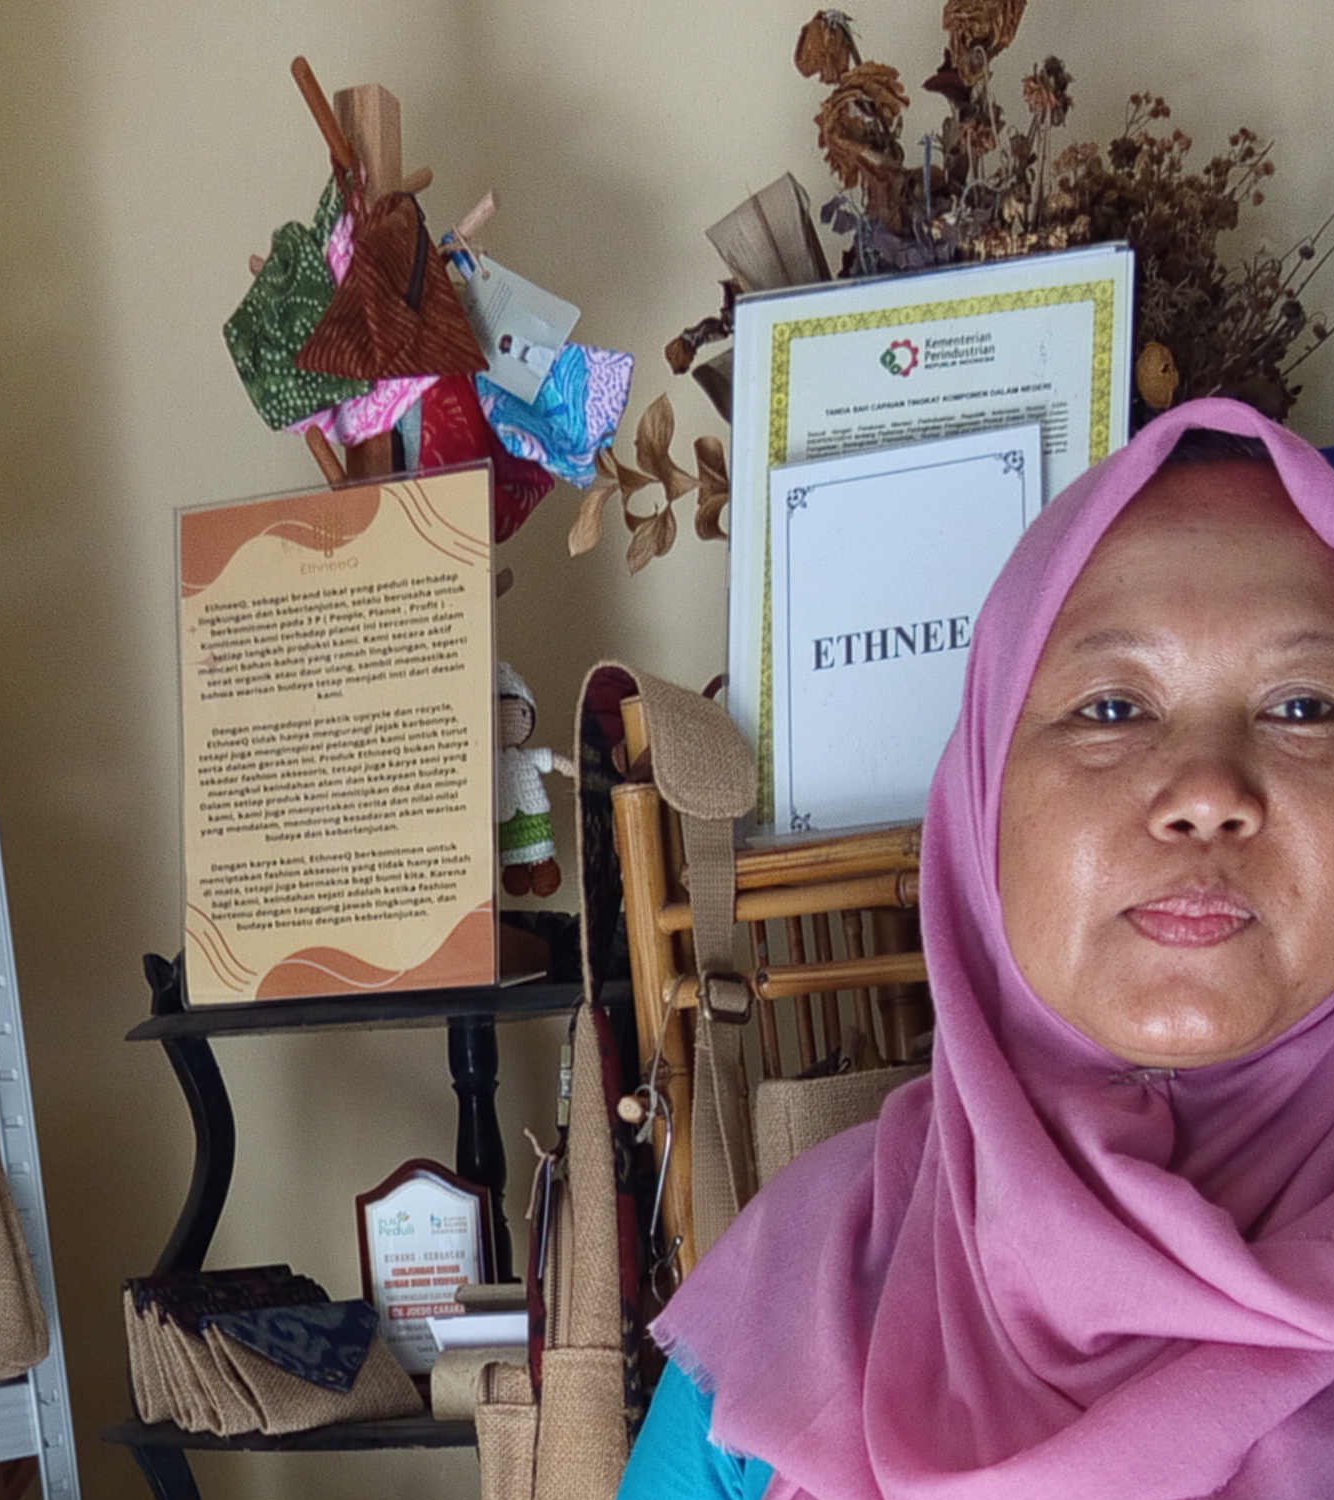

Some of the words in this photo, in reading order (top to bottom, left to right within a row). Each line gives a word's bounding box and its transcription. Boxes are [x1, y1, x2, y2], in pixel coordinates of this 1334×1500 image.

[924, 330, 992, 349] Kementerian
[924, 342, 995, 361] Perindustrian
[299, 555, 359, 577] EthneeQ
[197, 611, 253, 628] lingkungan
[254, 608, 273, 619] dan
[351, 594, 381, 606] selalu
[383, 588, 432, 602] berusaha
[433, 583, 465, 596] untuk
[250, 594, 289, 609] sebagai
[290, 589, 321, 601] brand
[322, 586, 348, 597] lokal
[349, 583, 375, 596] yang
[375, 578, 409, 592] peduli
[410, 571, 459, 588] terhadap
[199, 637, 251, 651] Komitmen
[253, 633, 278, 644] kami
[280, 627, 326, 643] terhadap
[327, 623, 360, 637] planet
[363, 621, 376, 630] ini
[378, 614, 429, 629] tercermin
[431, 609, 464, 622] dalam
[209, 621, 277, 638] berkomitmen
[279, 617, 304, 631] pada
[367, 605, 401, 617] Planet
[409, 600, 438, 612] Profit
[239, 655, 305, 671] bahan-bahan
[307, 653, 331, 665] yang
[333, 648, 367, 660] ramah
[431, 635, 468, 650] seperti
[244, 645, 285, 660] langkah
[285, 639, 330, 655] produksi
[362, 632, 389, 644] Kami
[391, 629, 425, 640] secara
[427, 624, 452, 635] aktif
[199, 689, 234, 701] bahwa
[235, 684, 275, 697] warisan
[277, 680, 313, 694] budaya
[315, 676, 343, 689] tetap
[344, 671, 386, 686] menjadi
[388, 668, 406, 679] inti
[408, 666, 429, 676] dari
[431, 661, 465, 674] desain
[206, 677, 232, 688] serat
[234, 672, 272, 687] organik
[274, 669, 297, 680] atau
[299, 666, 322, 677] daur
[357, 657, 392, 670] sambil
[393, 649, 458, 665] memastikan
[198, 871, 262, 887] menciptakan
[263, 868, 300, 879] fashion
[302, 864, 349, 876] aksesoris
[351, 863, 376, 874] yang
[377, 859, 404, 870] tidak
[406, 856, 439, 869] hanya
[440, 853, 471, 864] indah
[209, 860, 247, 874] Dengan
[249, 858, 277, 870] karya
[308, 851, 352, 864] EthneeQ
[353, 845, 424, 859] berkomitmen
[426, 842, 457, 853] untuk
[201, 888, 212, 897] di
[244, 883, 273, 895] tetapi
[274, 881, 296, 893] juga
[298, 876, 349, 889] bermakna
[351, 874, 373, 886] bagi
[375, 872, 402, 882] bumi
[429, 866, 466, 878] Karena
[210, 899, 232, 910] bagi
[263, 892, 315, 904] keindahan
[317, 889, 345, 902] sejati
[346, 886, 381, 897] adalah
[383, 883, 416, 894] ketika
[418, 880, 457, 891] fashion
[210, 909, 253, 920] bertemu
[254, 906, 291, 919] dengan
[293, 902, 340, 916] tanggung
[341, 899, 373, 912] jawab
[436, 892, 457, 902] dan
[235, 920, 273, 933] budaya
[274, 917, 313, 928] bersatu
[315, 914, 352, 927] dengan
[378, 1223, 415, 1236] Peduli
